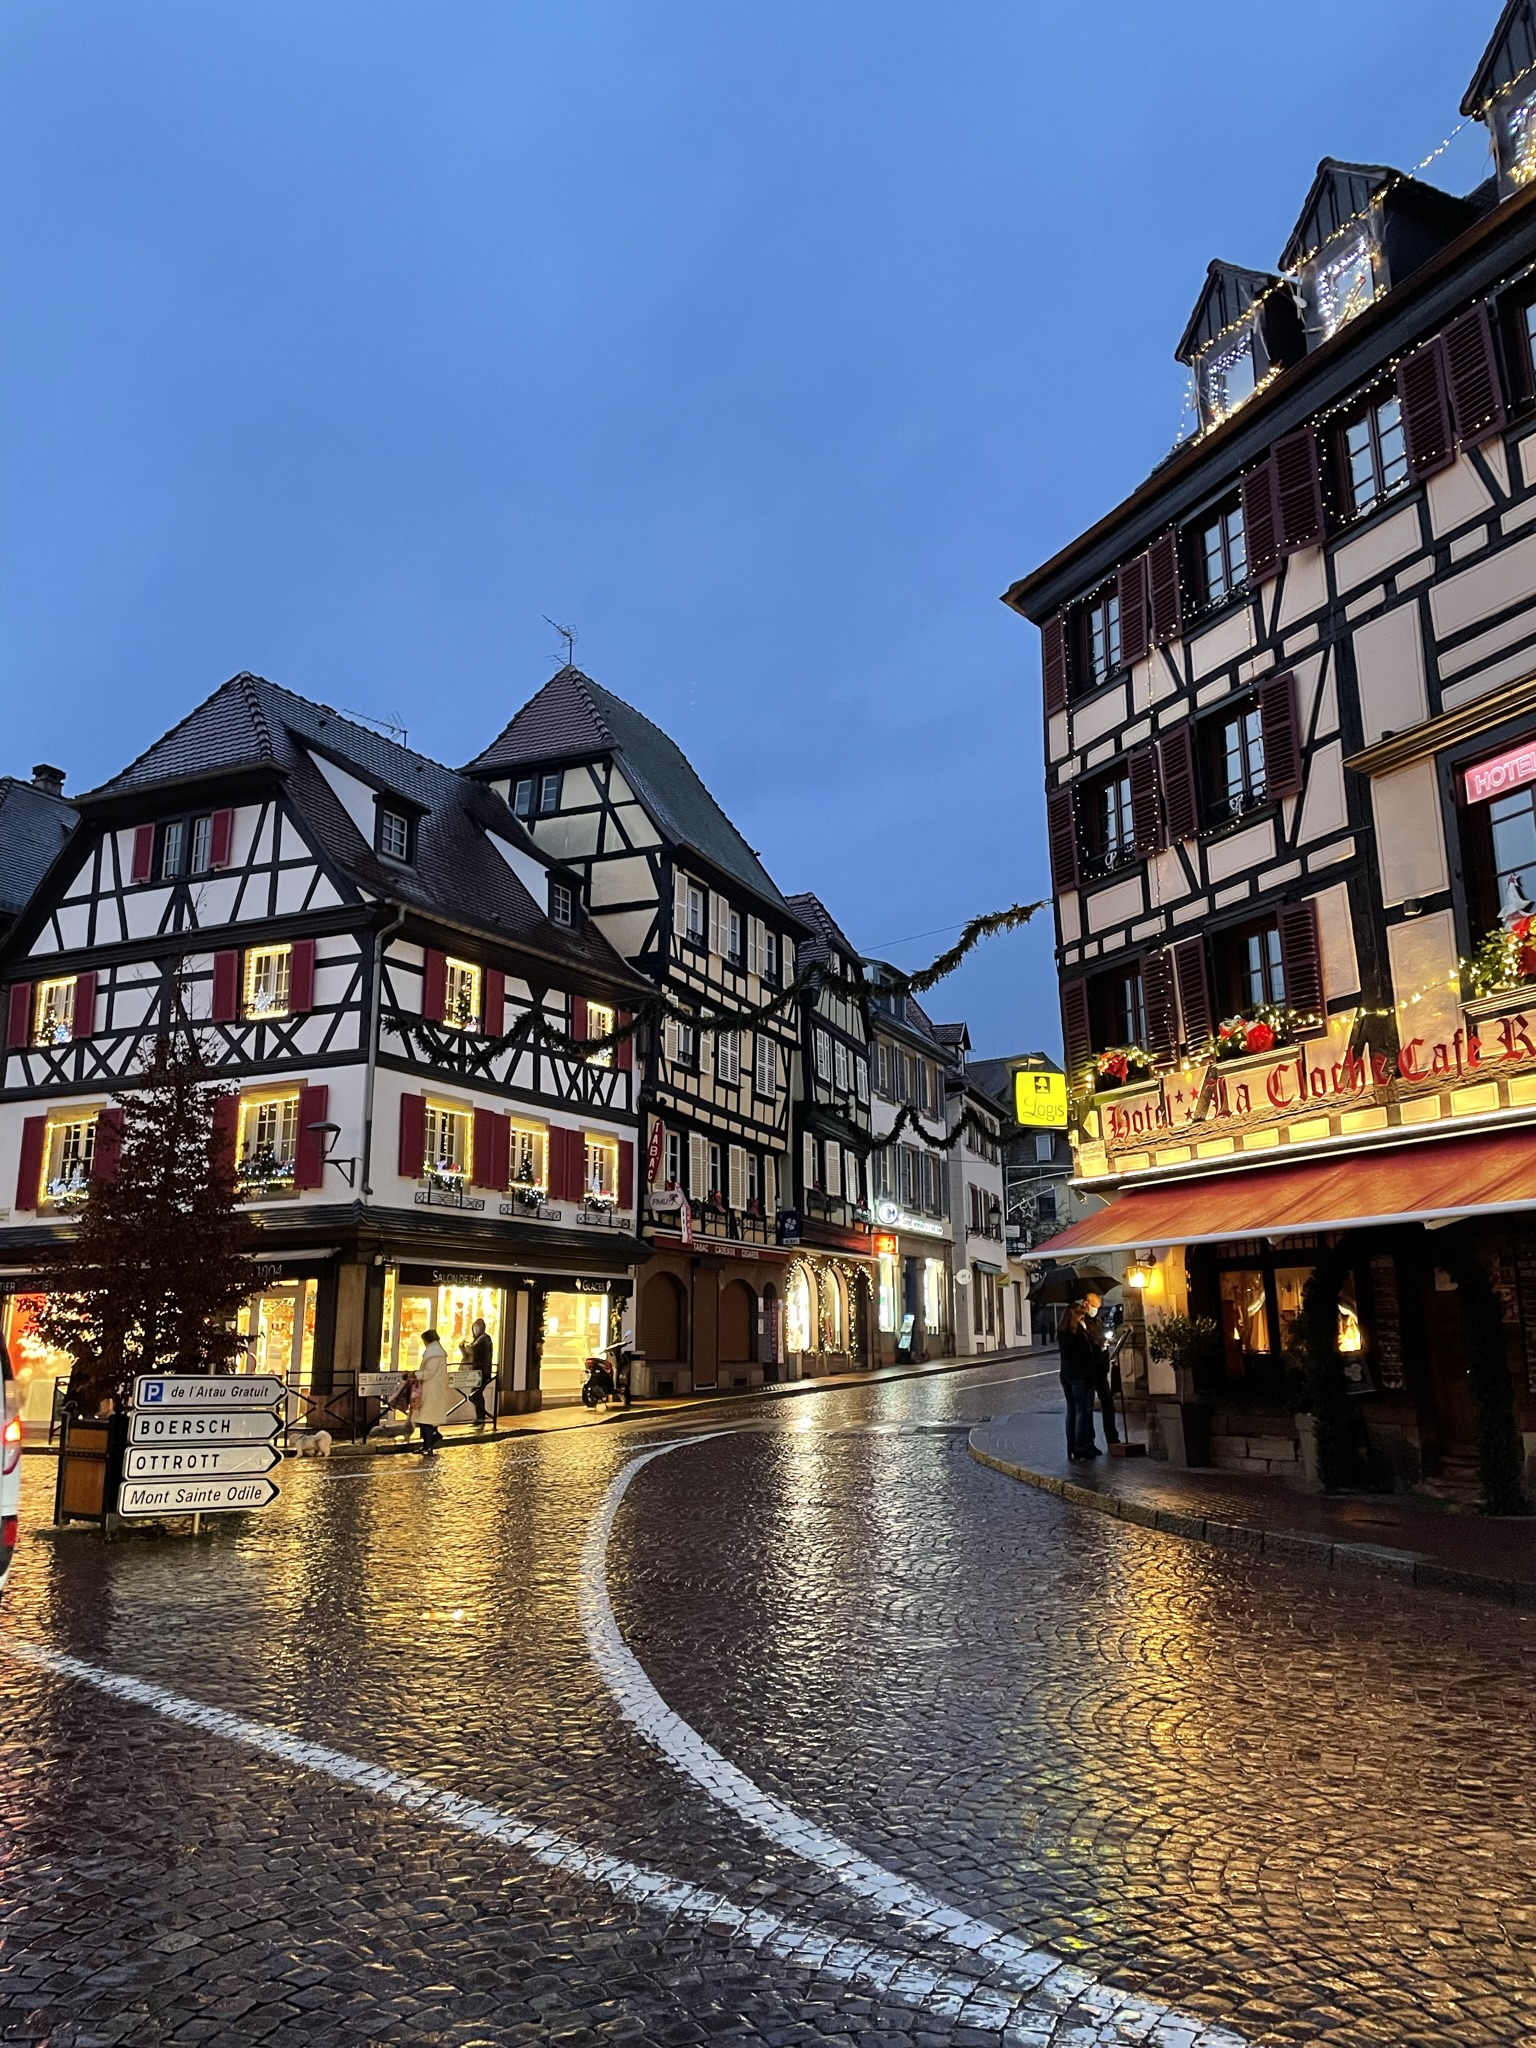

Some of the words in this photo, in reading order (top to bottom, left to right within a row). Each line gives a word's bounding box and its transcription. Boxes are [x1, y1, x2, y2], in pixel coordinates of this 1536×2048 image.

[1475, 751, 1536, 795] HOTEL
[1266, 1045, 1393, 1108] Cloche
[1023, 1095, 1065, 1122] Logis
[648, 1122, 661, 1180] TABAC
[652, 1198, 669, 1206] PMU
[693, 1243, 709, 1253] TABAC
[714, 1246, 736, 1256] CADEAUX
[741, 1249, 759, 1259] CIGARES
[432, 1270, 458, 1284] SALON
[459, 1274, 469, 1284] DE
[582, 1279, 605, 1292] GLACES
[147, 1385, 160, 1401] P
[171, 1386, 185, 1398] de
[231, 1386, 269, 1397] Gratuit
[140, 1419, 231, 1435] BOERSCH
[136, 1454, 220, 1470] OTTROTT
[130, 1490, 170, 1505] Mont
[175, 1488, 221, 1503] Sainte
[227, 1485, 262, 1501] Odile
